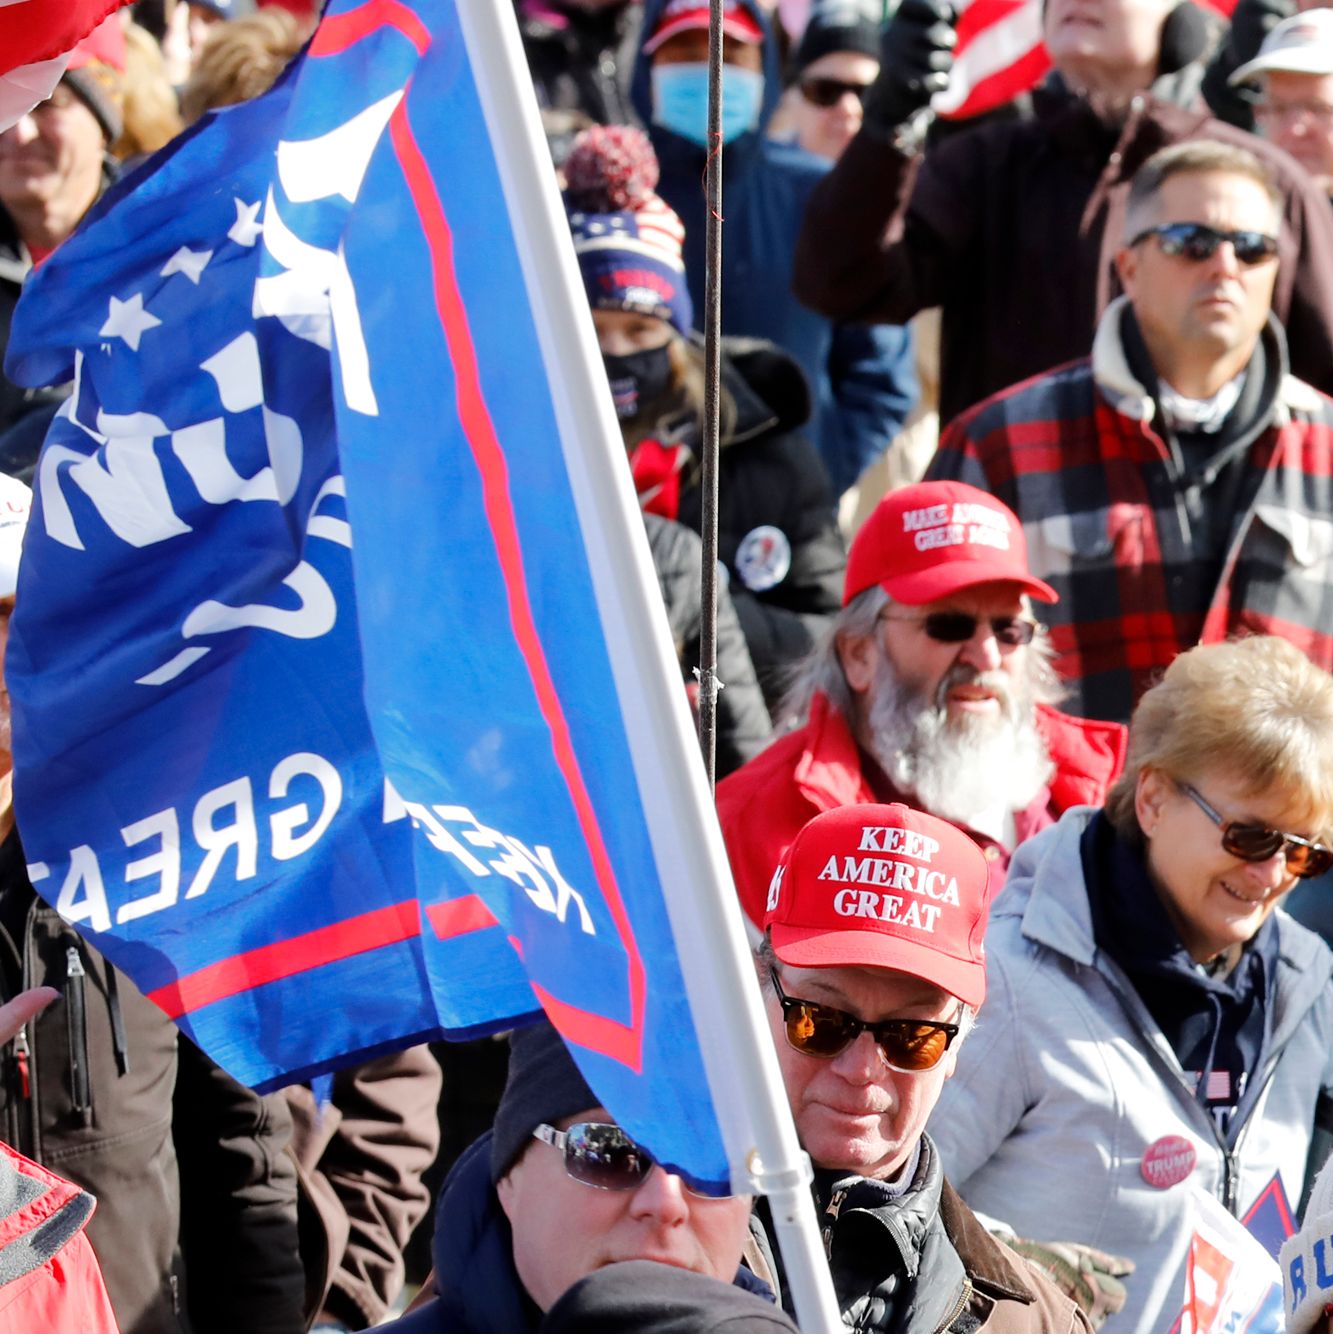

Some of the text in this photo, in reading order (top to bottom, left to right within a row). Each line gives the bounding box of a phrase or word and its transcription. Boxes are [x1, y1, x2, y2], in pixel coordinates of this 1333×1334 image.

[857, 826, 940, 863] KEEP
[817, 855, 961, 907] AMERICA
[833, 888, 942, 933] GREAT
